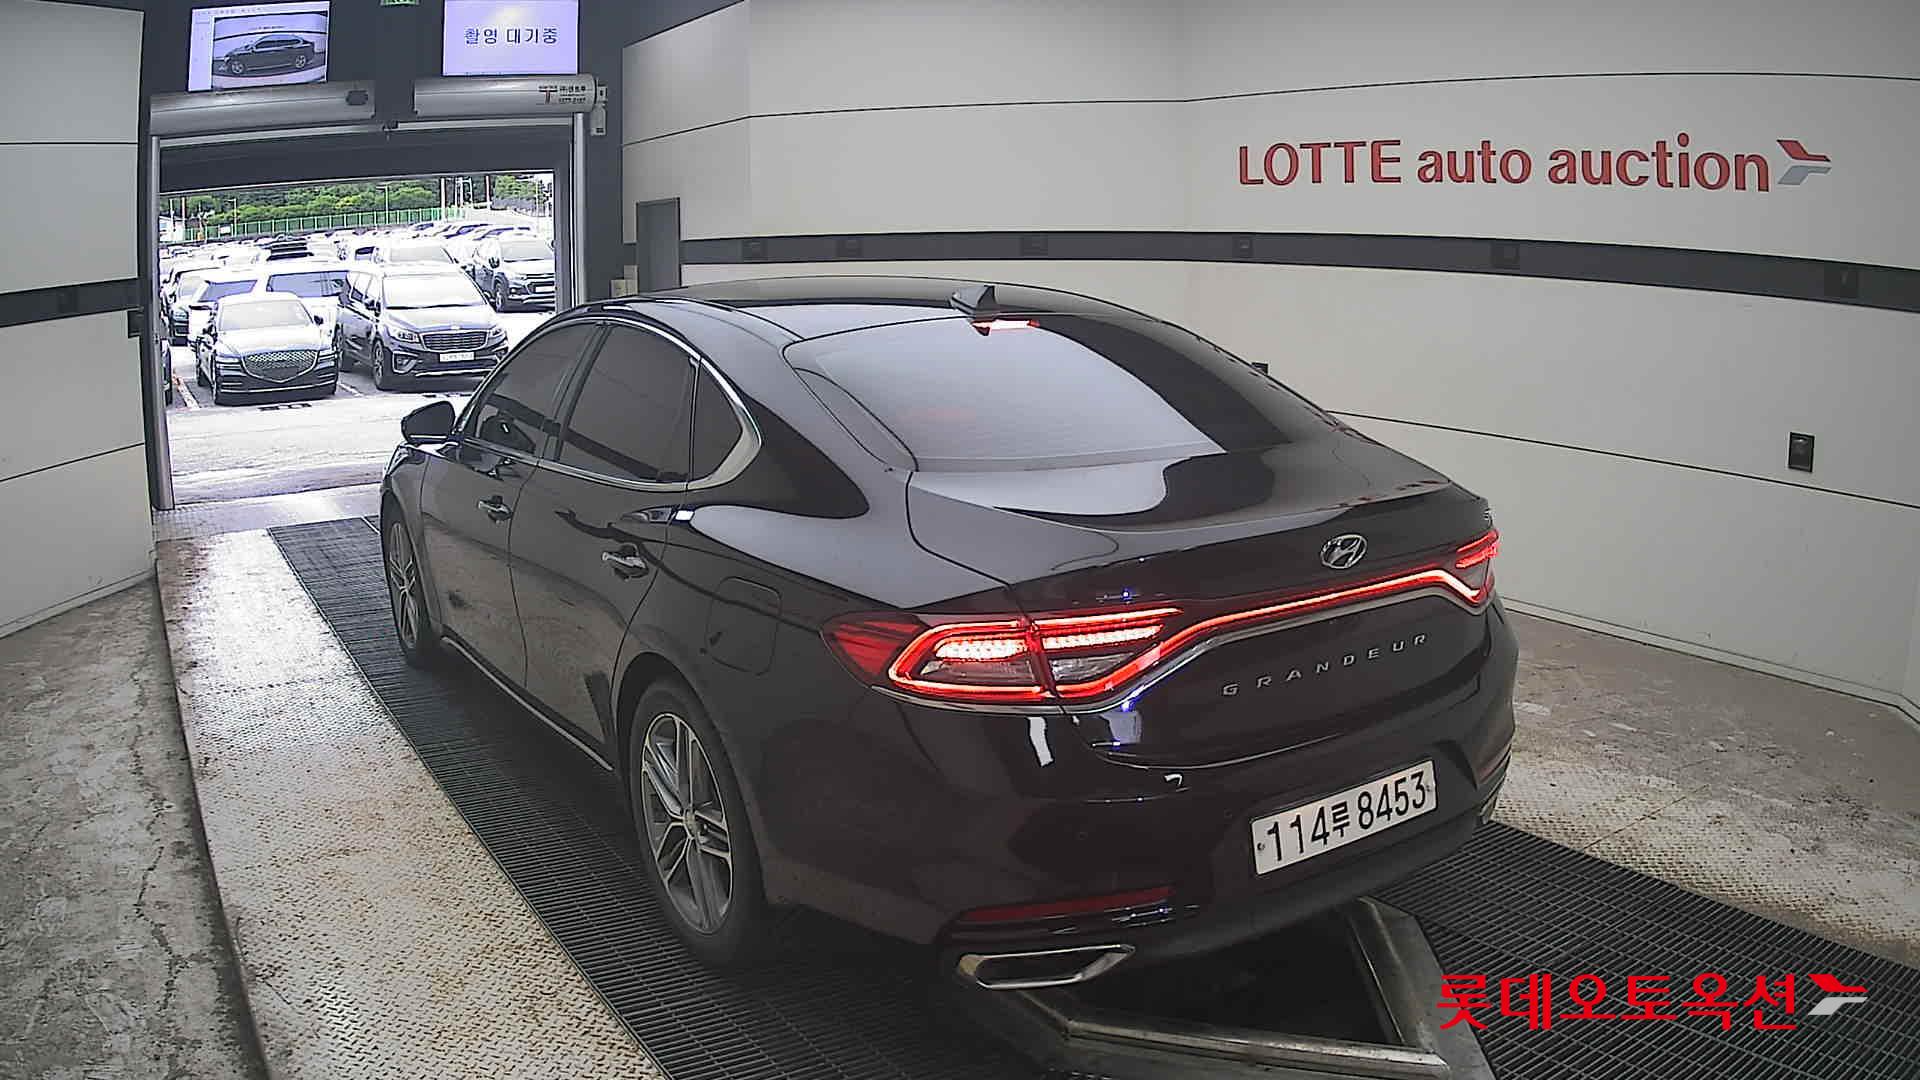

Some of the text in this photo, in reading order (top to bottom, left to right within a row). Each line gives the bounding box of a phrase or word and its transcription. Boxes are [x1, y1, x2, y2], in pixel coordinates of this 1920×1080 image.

[506, 27, 558, 45] 대기중
[1240, 133, 1769, 192] LOTTE auto auction
[1222, 634, 1427, 696] GRANDEUR
[1357, 770, 1426, 830] 8453
